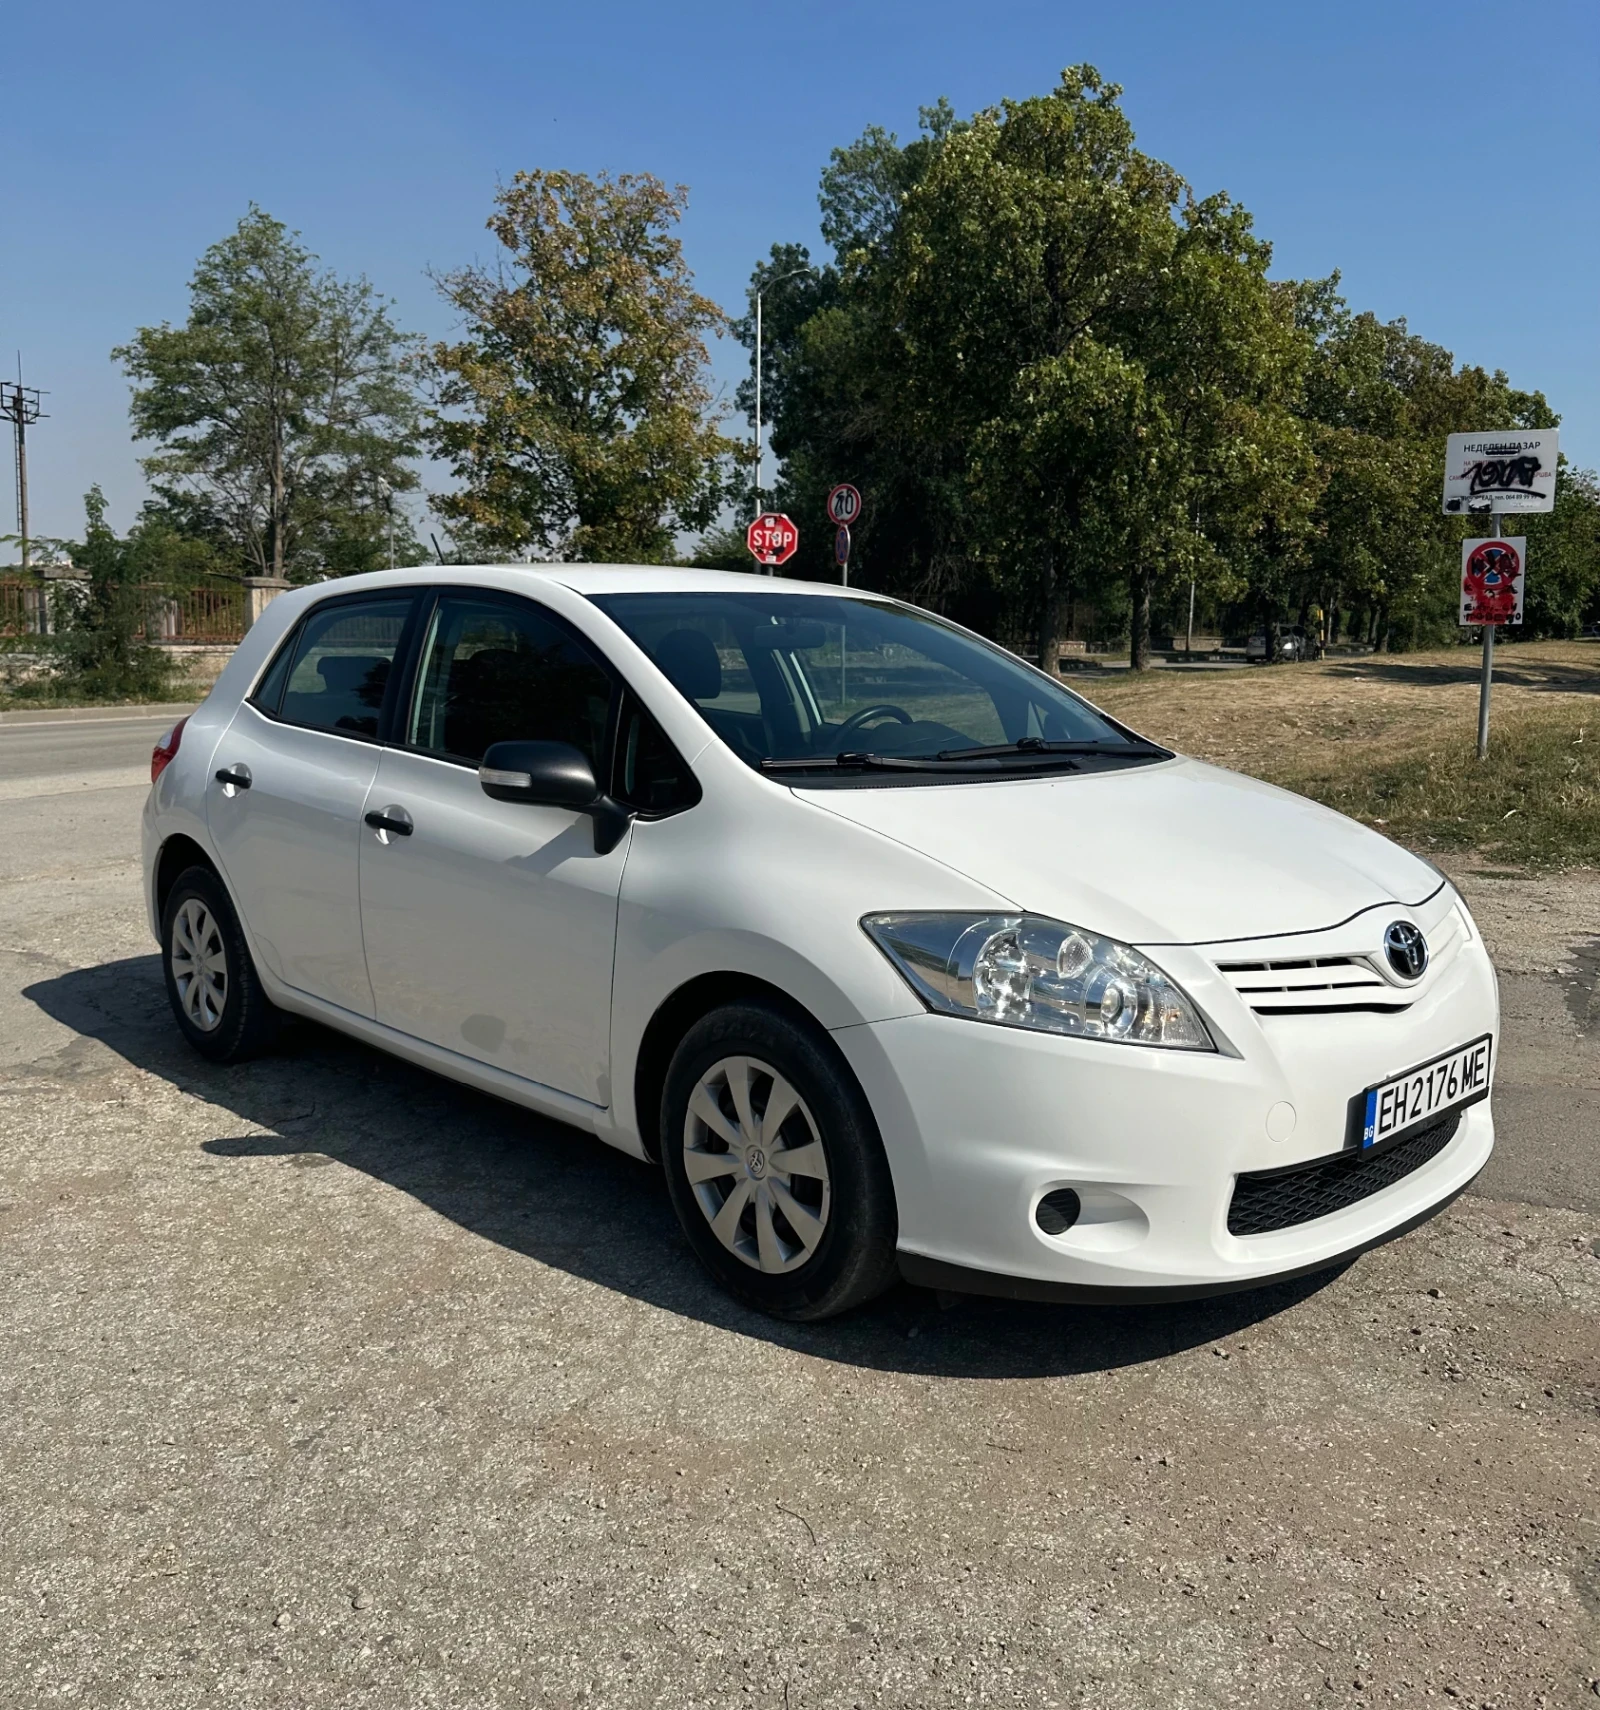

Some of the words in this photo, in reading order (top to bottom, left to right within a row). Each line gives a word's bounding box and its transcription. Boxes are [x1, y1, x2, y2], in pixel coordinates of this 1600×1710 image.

[1508, 441, 1541, 451] ПАЗАР
[753, 529, 793, 548] STOP
[1461, 1045, 1486, 1095] ME
[1363, 1125, 1374, 1141] BG
